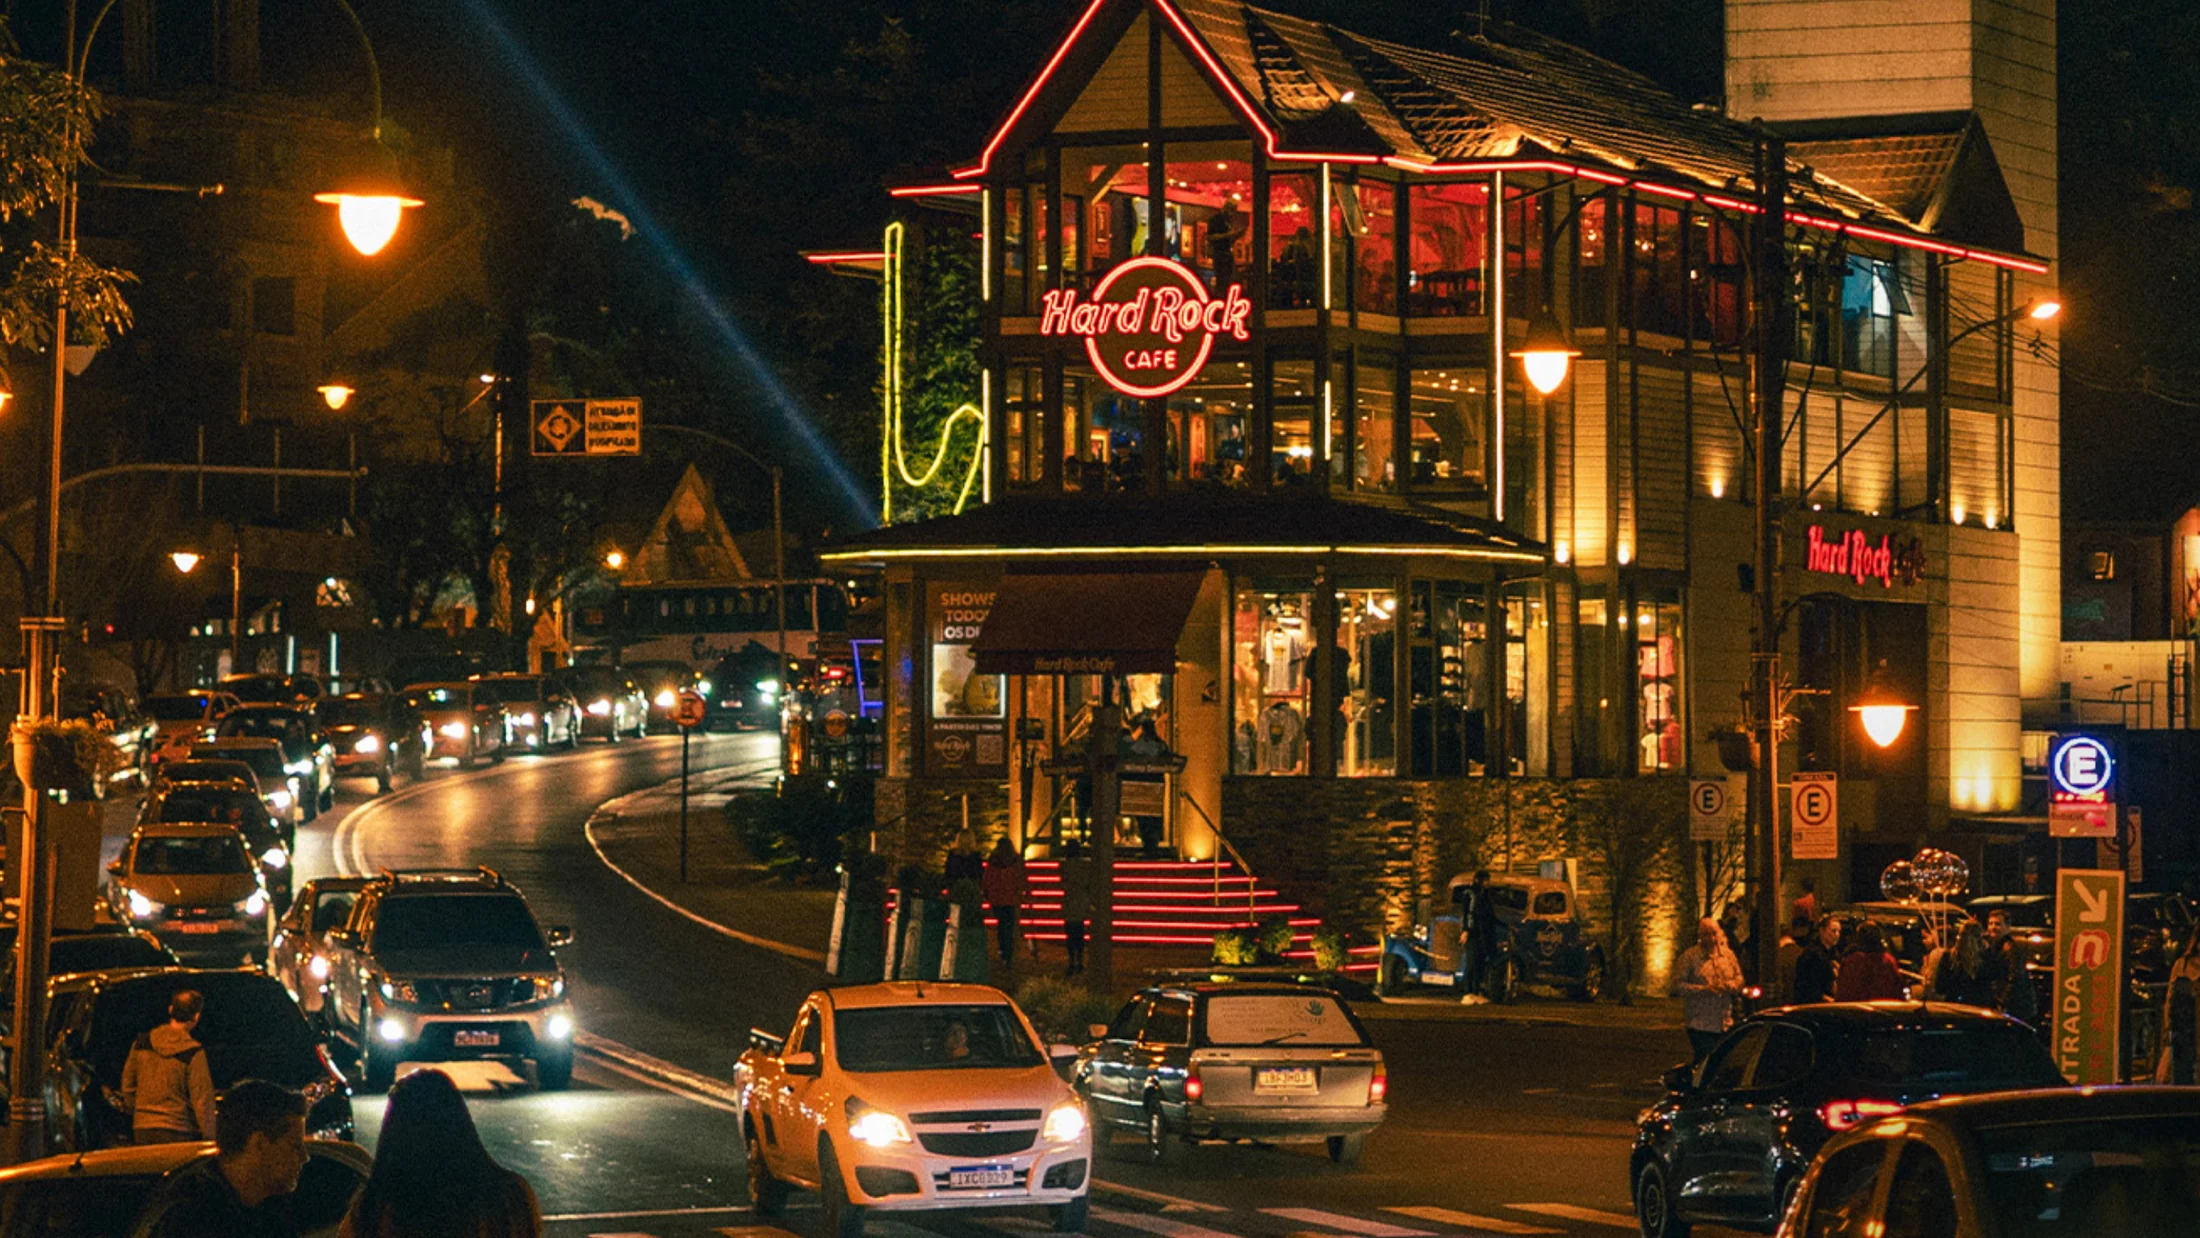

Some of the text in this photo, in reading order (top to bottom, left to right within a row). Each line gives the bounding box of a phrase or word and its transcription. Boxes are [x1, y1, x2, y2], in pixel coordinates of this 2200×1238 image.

[1040, 283, 1252, 344] Hard Rock
[1124, 350, 1178, 370] CAFE
[1808, 524, 1850, 575] Hard
[1850, 529, 1892, 589] Rock
[940, 592, 997, 606] SHOWS
[944, 609, 990, 622] TODO
[944, 625, 964, 639] OS
[2068, 746, 2098, 785] E
[1703, 789, 1714, 809] E
[1807, 792, 1821, 817] E
